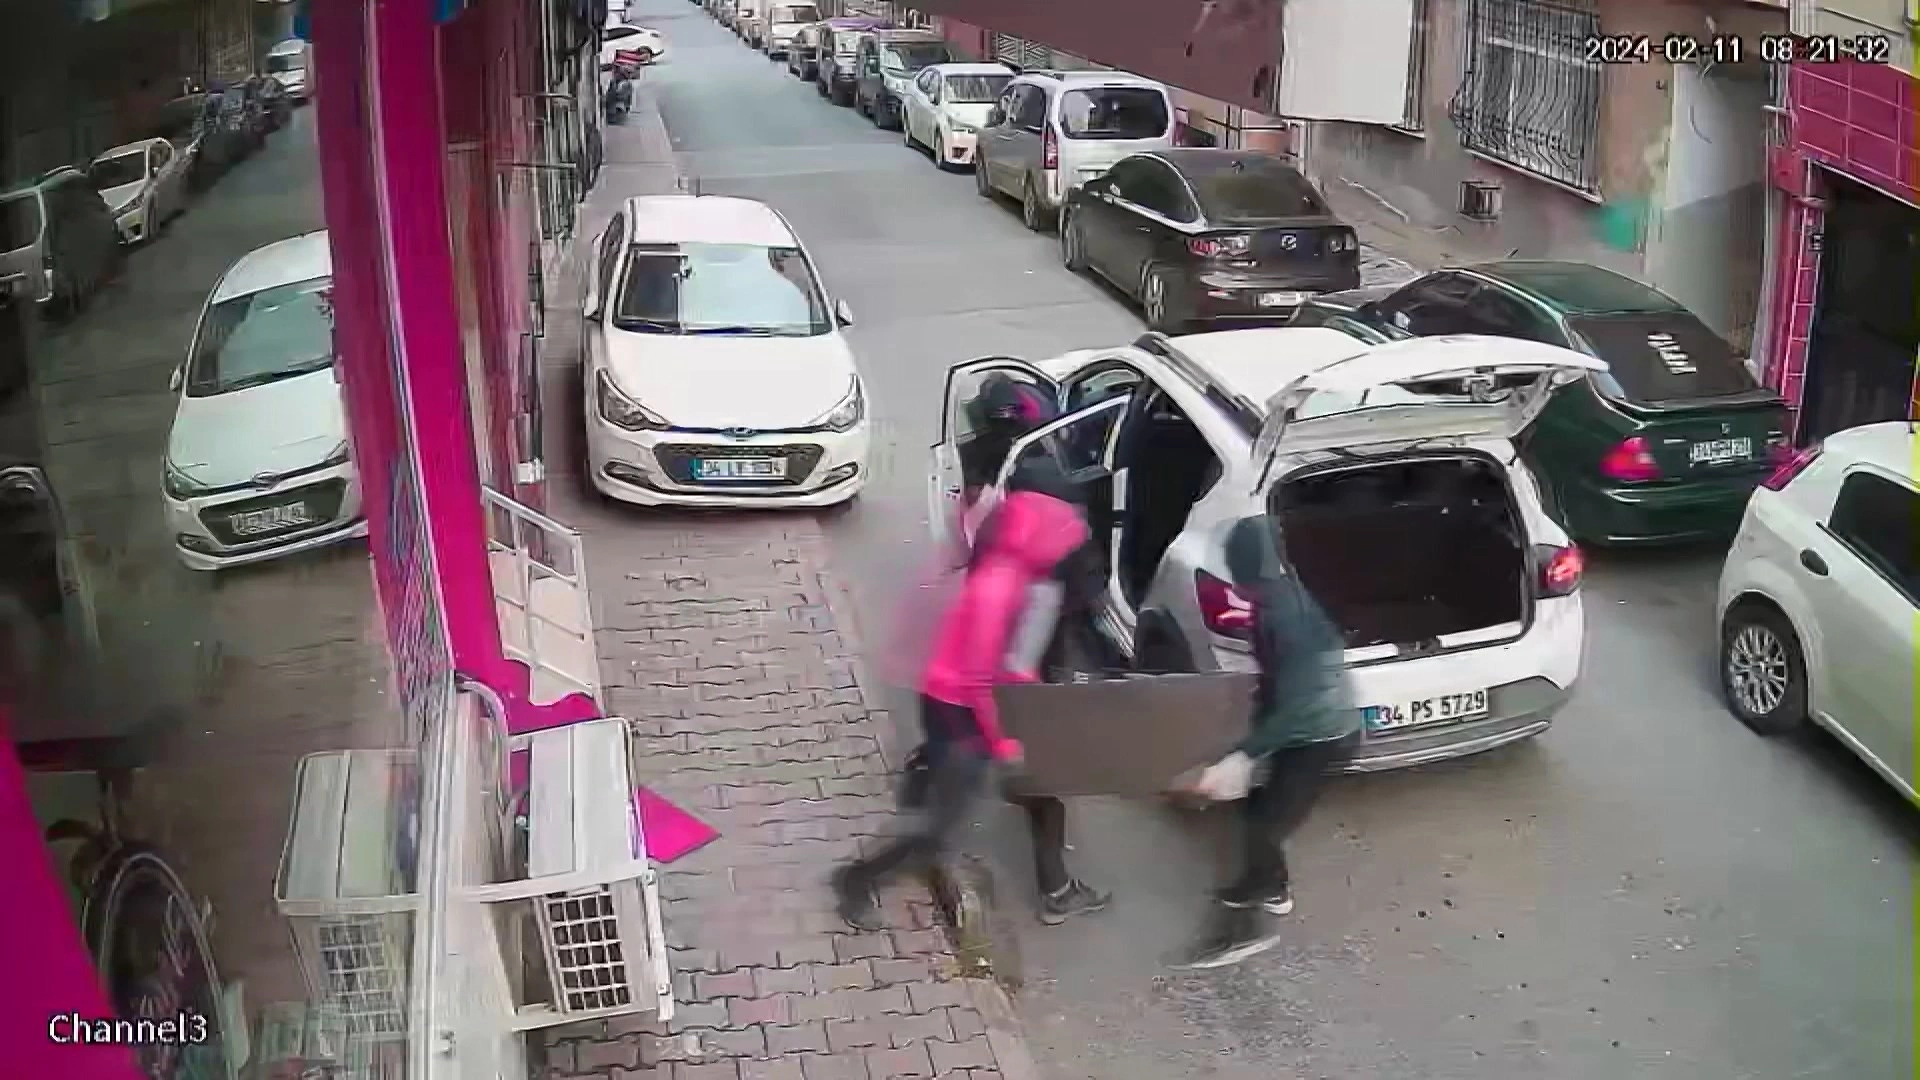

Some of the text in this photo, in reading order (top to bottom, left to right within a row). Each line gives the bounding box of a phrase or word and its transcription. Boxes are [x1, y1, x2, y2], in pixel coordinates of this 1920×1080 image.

[1380, 690, 1485, 725] 34 PS 5729
